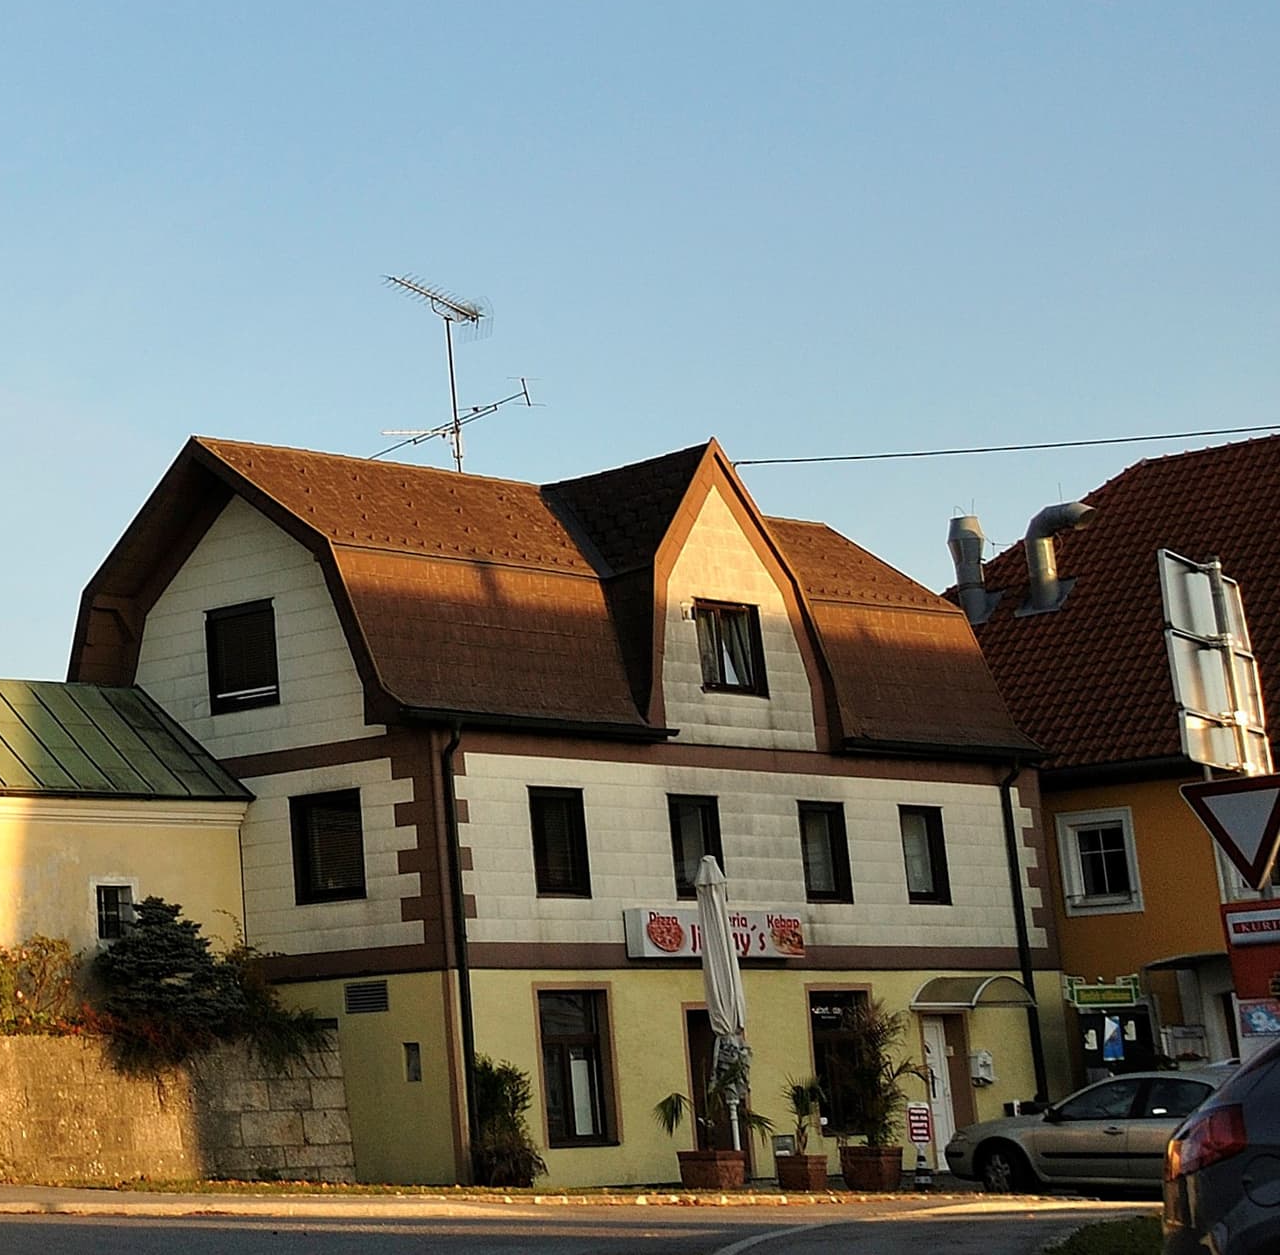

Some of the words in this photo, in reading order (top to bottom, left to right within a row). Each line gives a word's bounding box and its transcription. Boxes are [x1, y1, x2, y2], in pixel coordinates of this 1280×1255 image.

[648, 911, 678, 926] Pizza
[766, 914, 800, 929] Kebap
[1240, 920, 1280, 933] KURI
